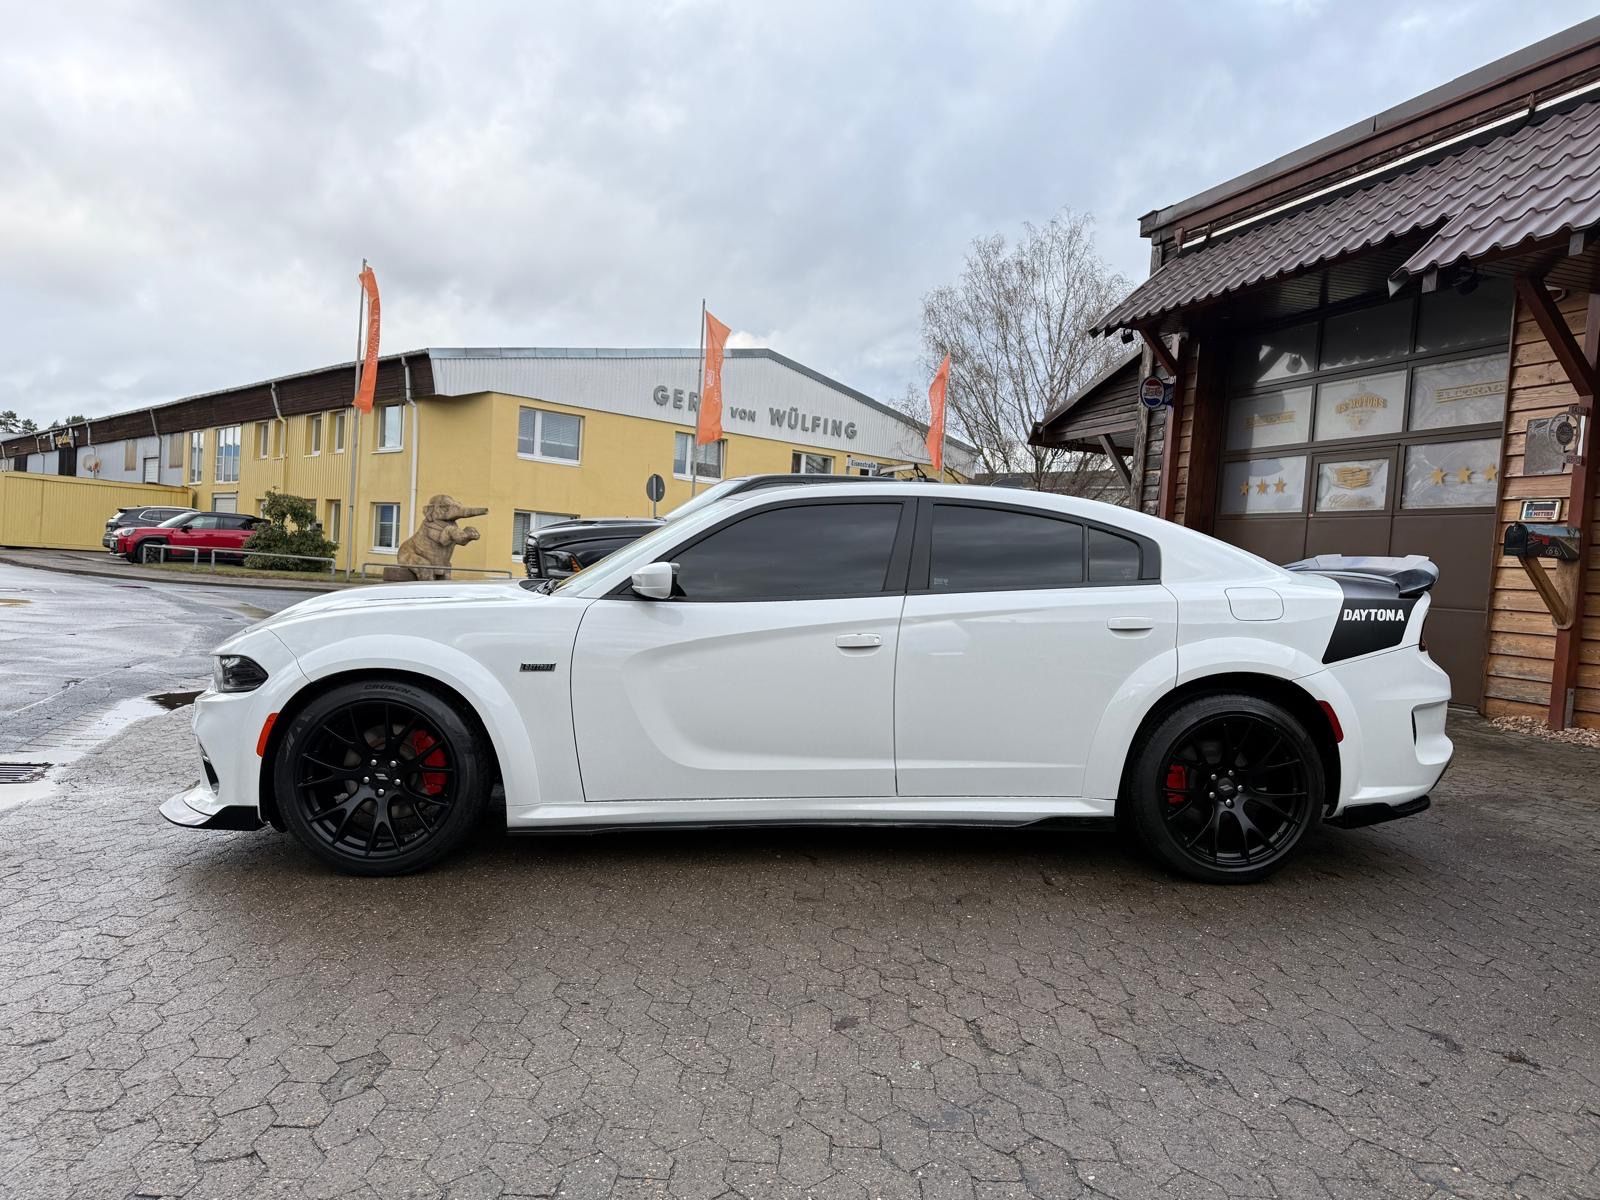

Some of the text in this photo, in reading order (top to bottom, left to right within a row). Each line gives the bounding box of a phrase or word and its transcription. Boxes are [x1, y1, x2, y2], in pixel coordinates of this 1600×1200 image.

[653, 385, 858, 440] GER VON WÜLFING
[851, 459, 876, 469] Eisenstraße
[1342, 608, 1405, 621] DAYTONA
